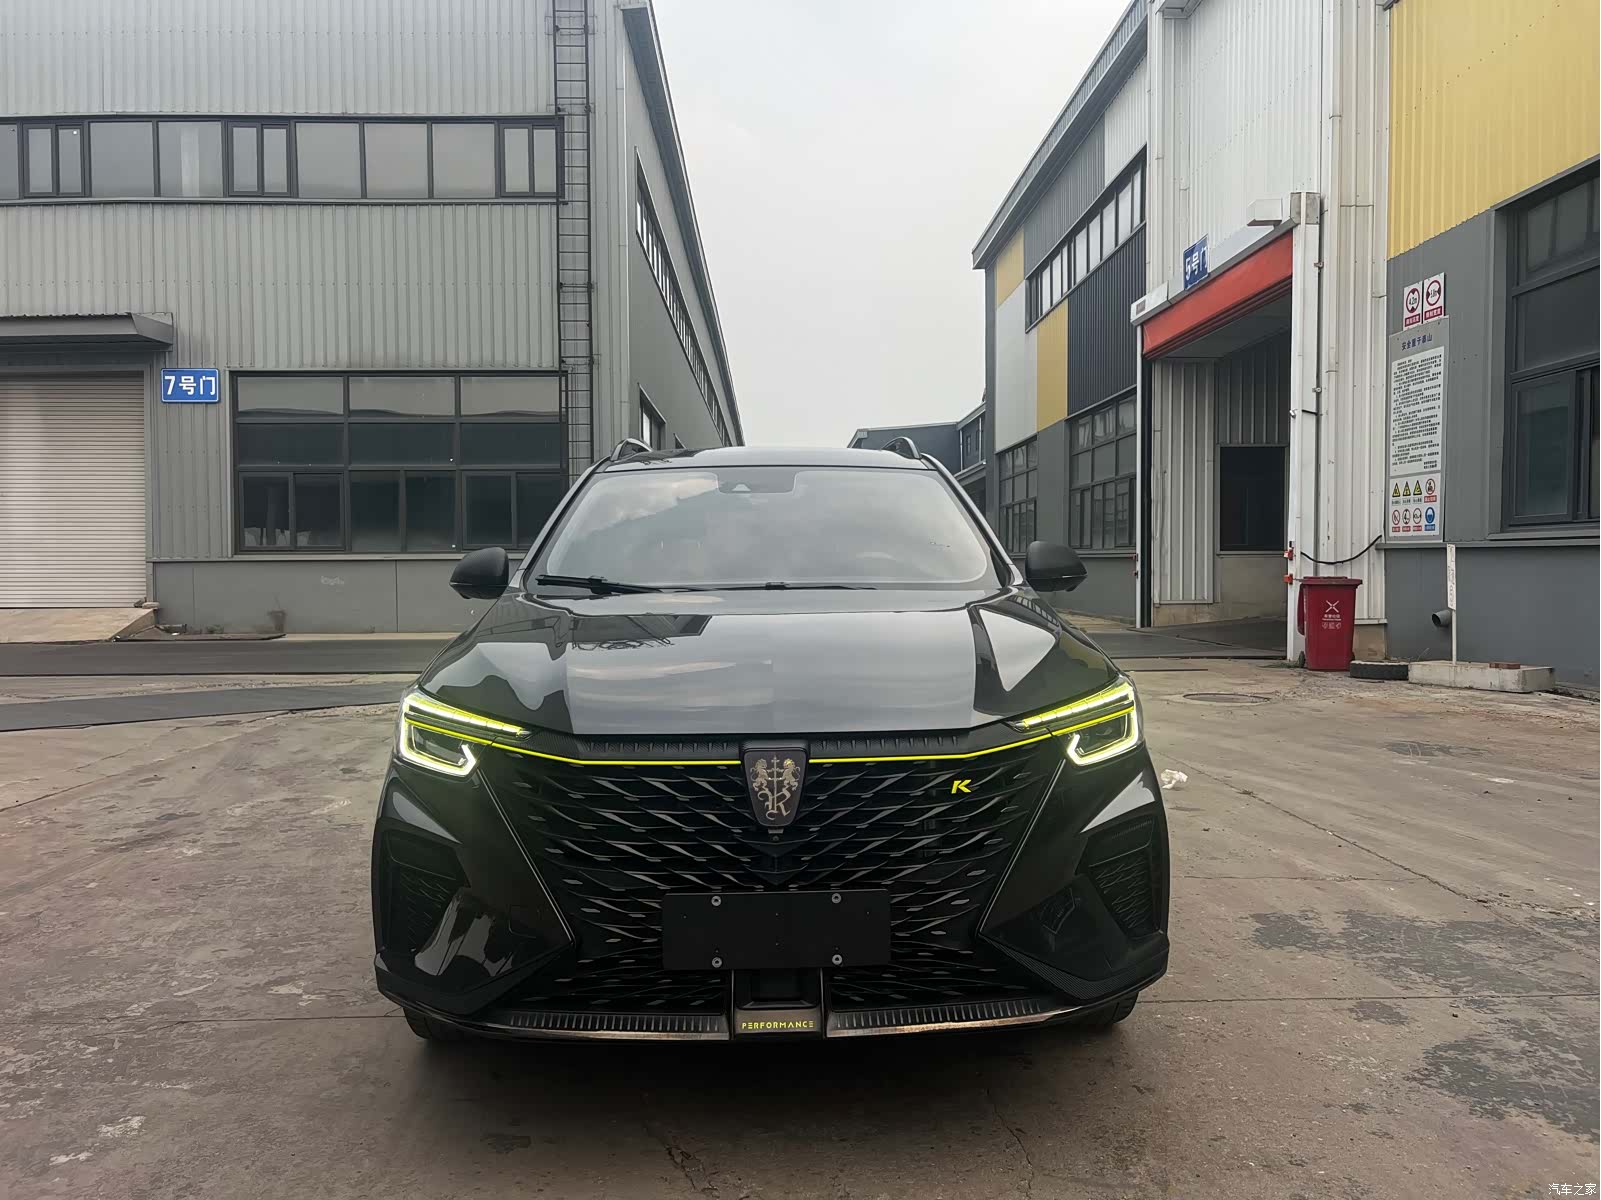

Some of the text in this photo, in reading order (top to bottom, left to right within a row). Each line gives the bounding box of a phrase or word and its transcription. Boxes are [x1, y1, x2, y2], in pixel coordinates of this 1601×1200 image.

[1185, 246, 1208, 281] 5号门
[164, 375, 216, 396] 7号门
[741, 1020, 814, 1030] PERFORMANCE
